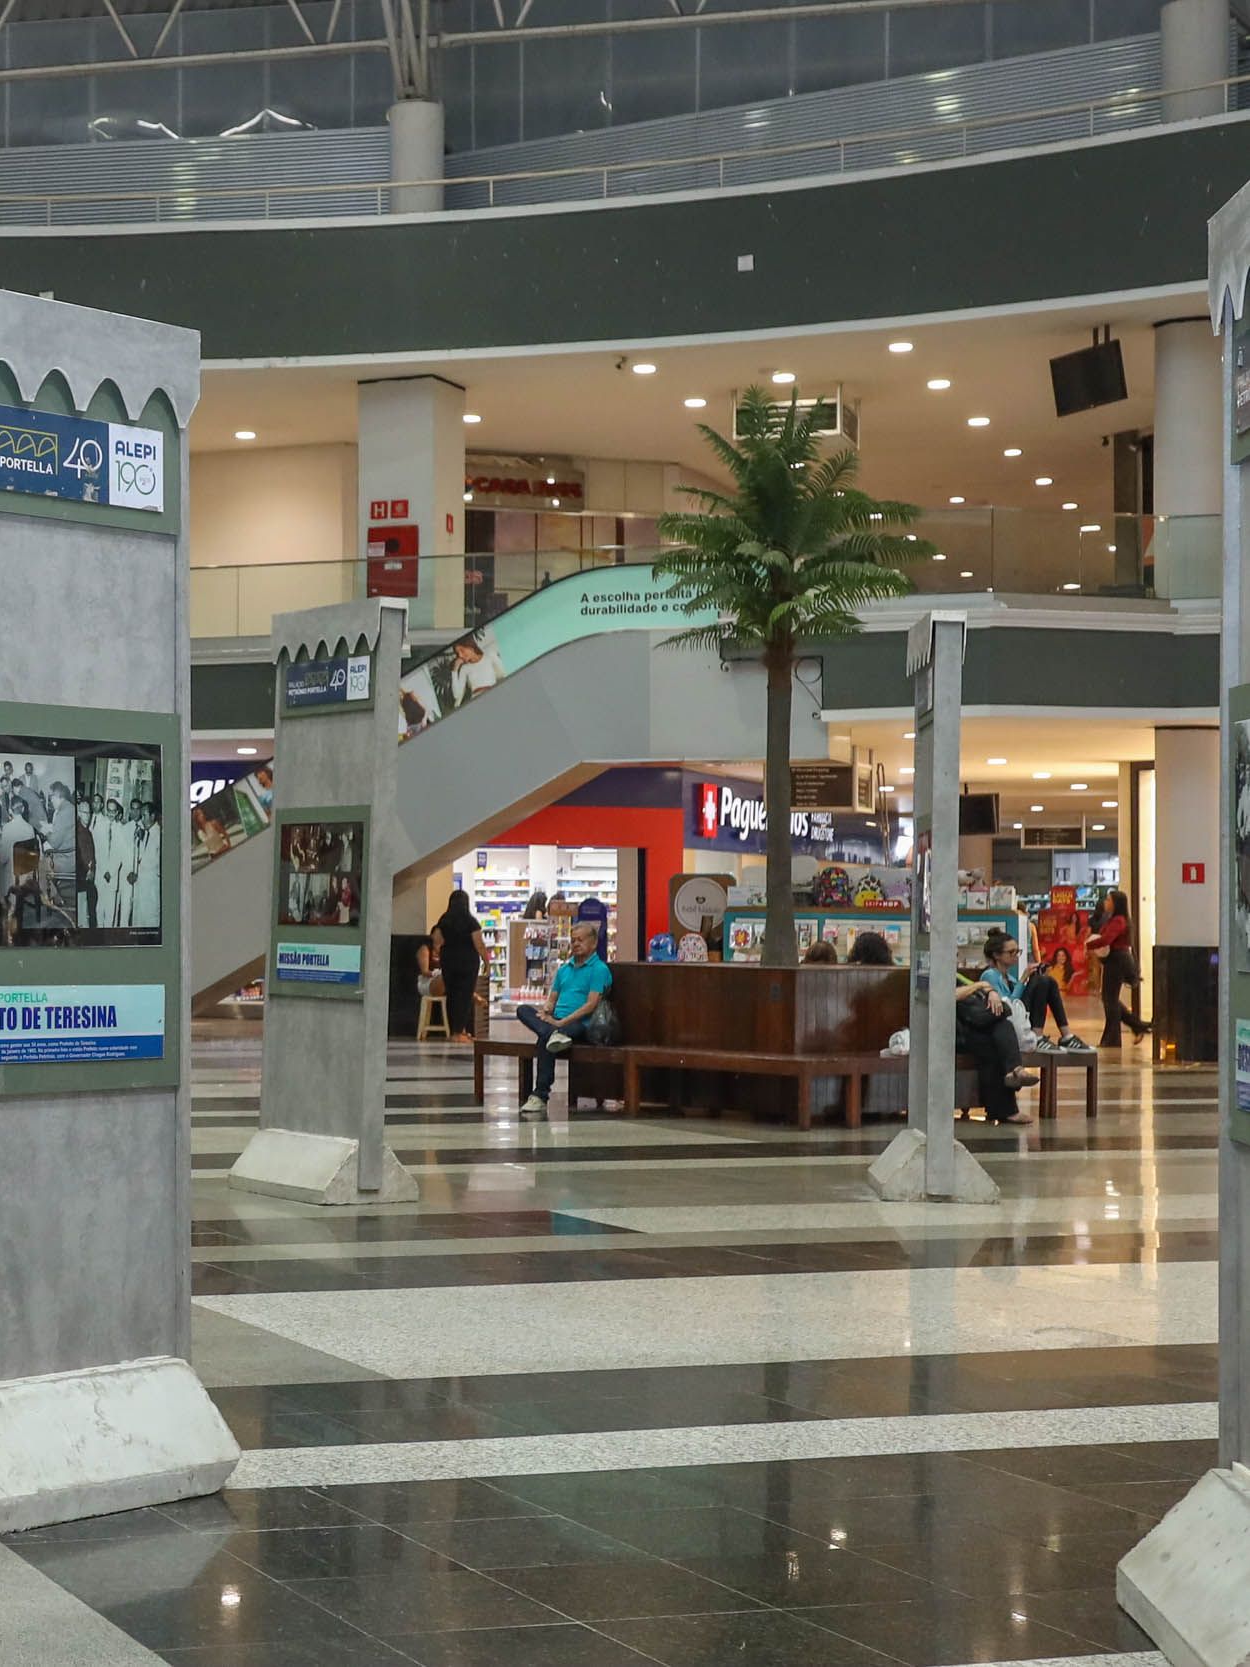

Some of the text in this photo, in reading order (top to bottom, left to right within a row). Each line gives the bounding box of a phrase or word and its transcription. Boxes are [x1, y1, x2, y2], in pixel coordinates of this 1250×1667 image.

[62, 437, 103, 479] 40
[115, 440, 156, 461] ALEPI
[0, 455, 54, 475] PORTELLA
[115, 460, 156, 496] 190
[374, 503, 386, 517] H
[581, 592, 589, 603] A
[592, 591, 640, 603] escolha
[581, 602, 657, 616] durabilidade
[661, 604, 669, 612] e
[22, 1006, 41, 1031] DE
[45, 1005, 117, 1031] TERESINA
